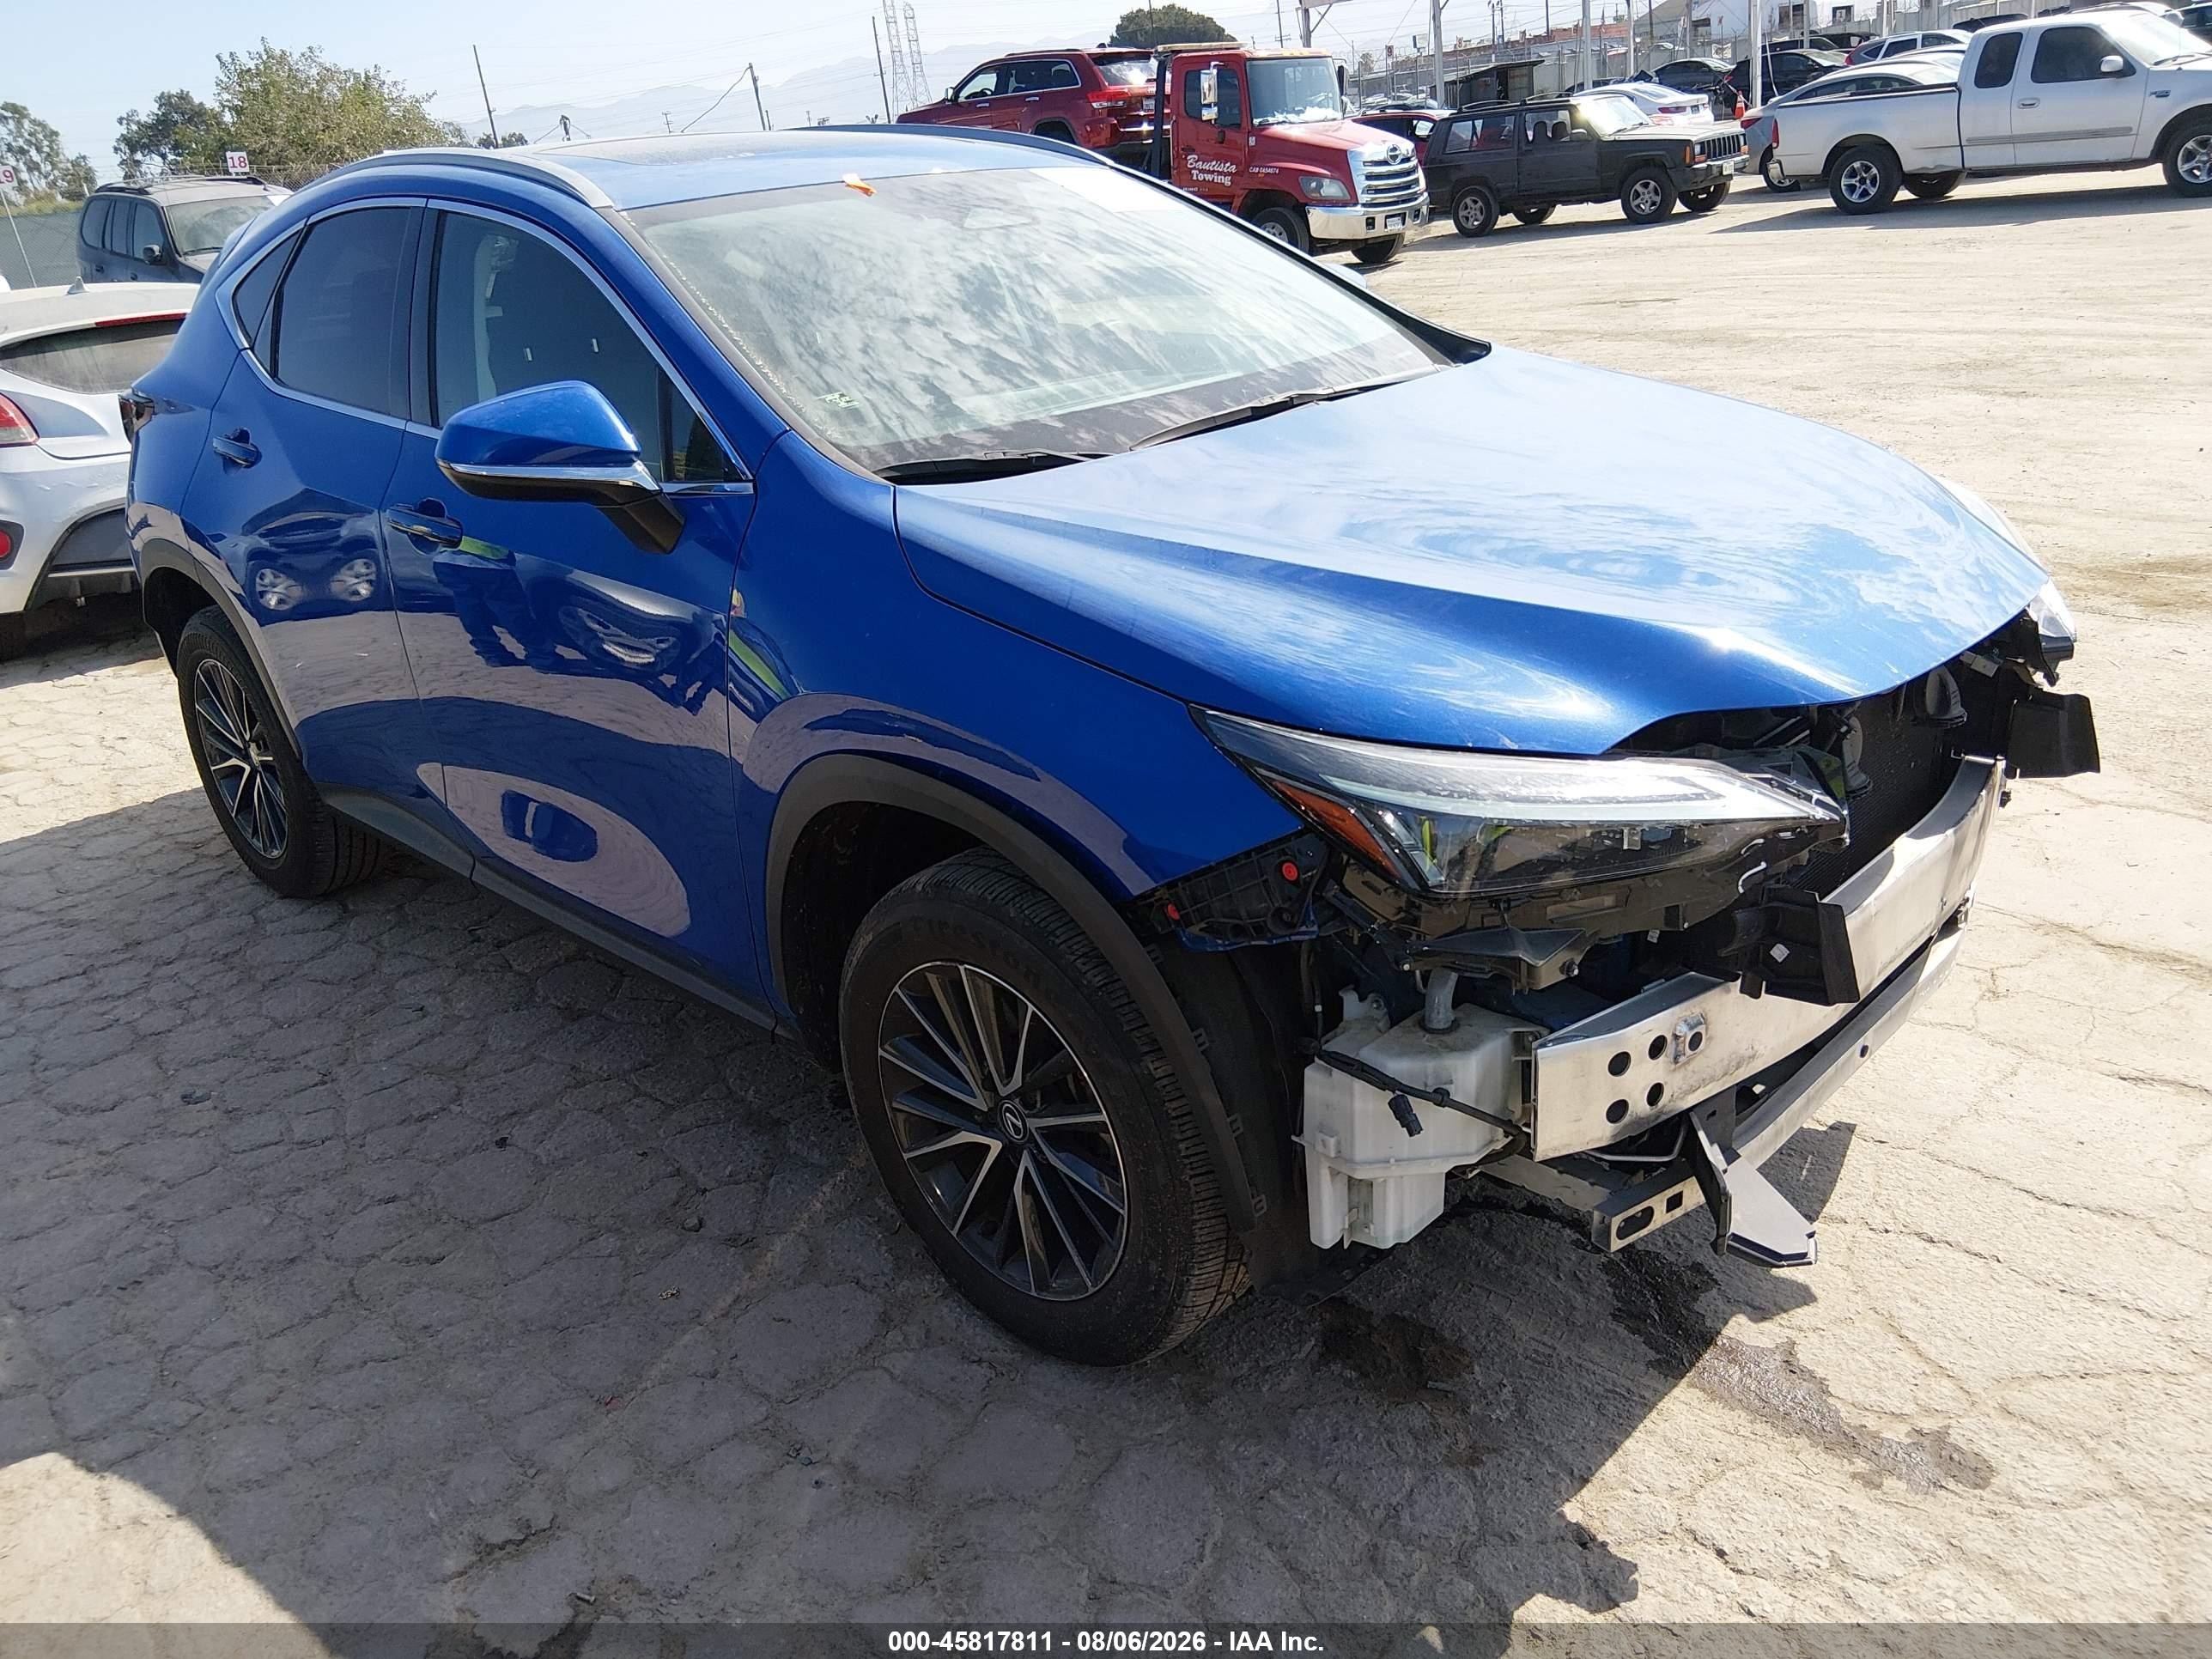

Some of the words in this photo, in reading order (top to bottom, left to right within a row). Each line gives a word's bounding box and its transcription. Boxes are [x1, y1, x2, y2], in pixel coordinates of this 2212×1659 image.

[1387, 46, 1393, 57] 9
[228, 155, 247, 168] 18
[1187, 155, 1237, 173] Bautista
[1191, 170, 1231, 186] Towing
